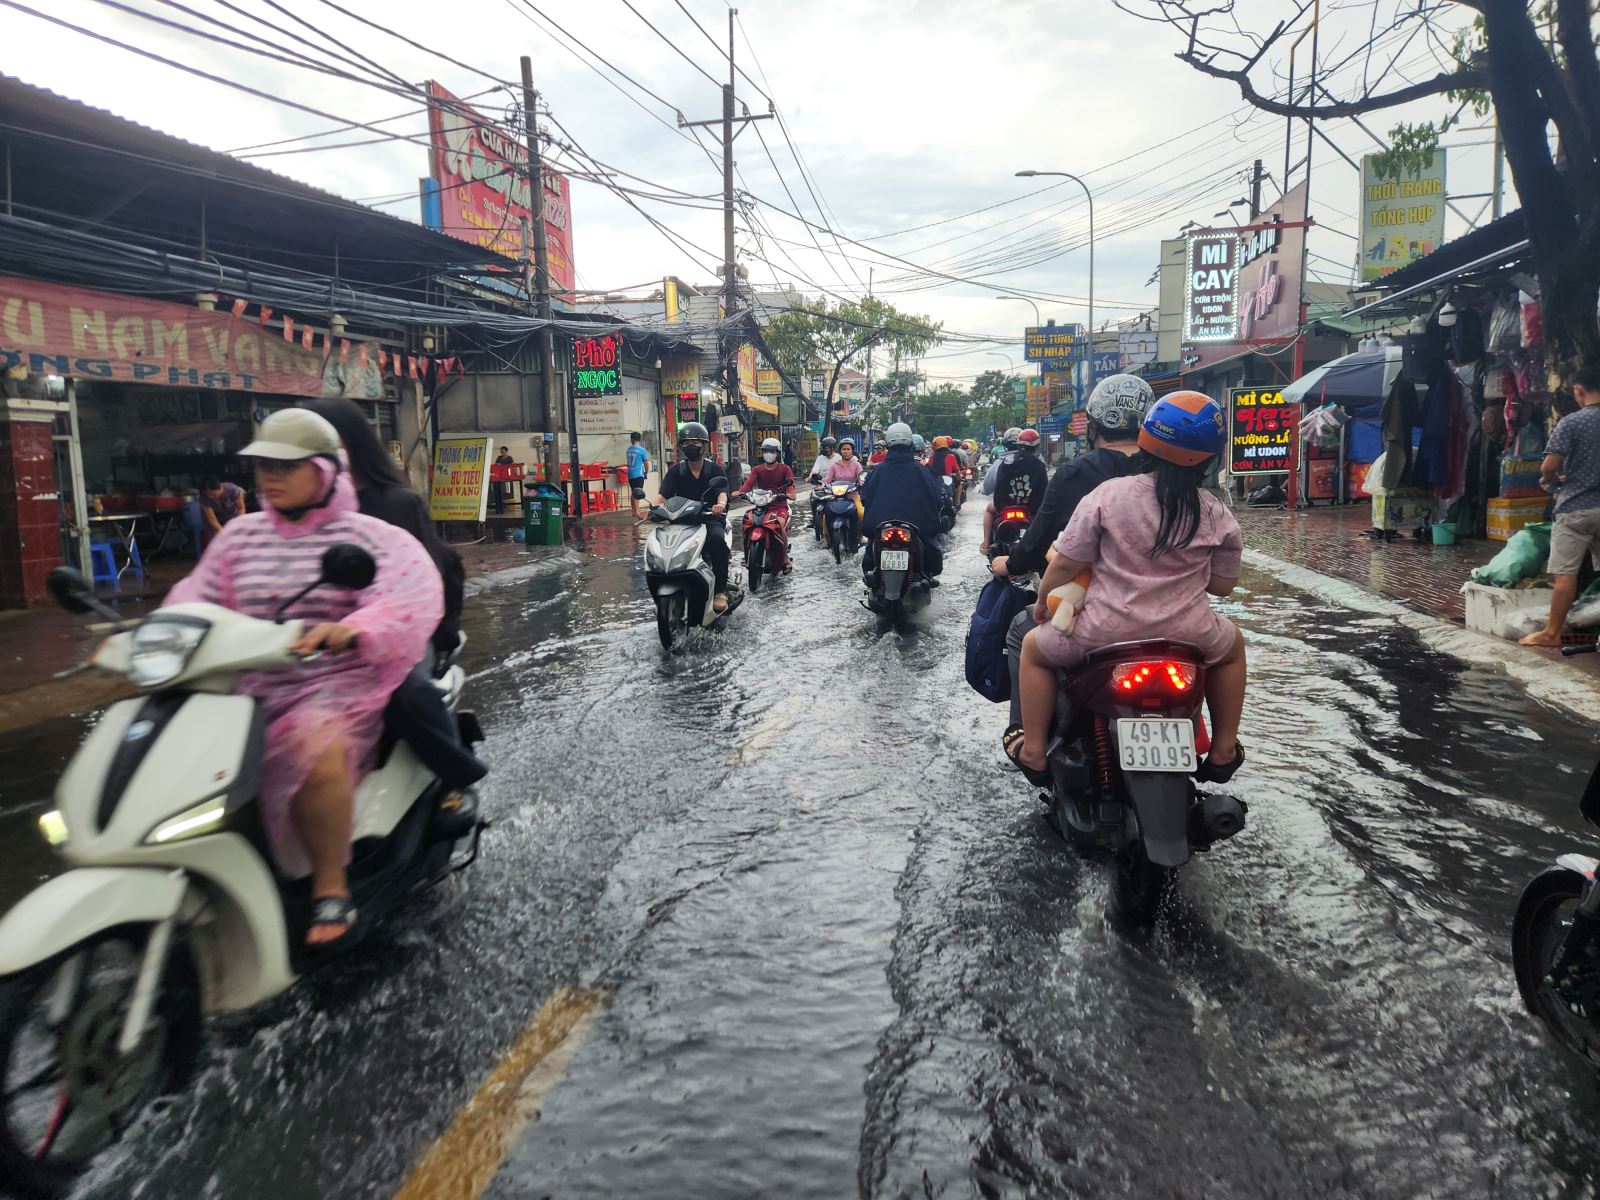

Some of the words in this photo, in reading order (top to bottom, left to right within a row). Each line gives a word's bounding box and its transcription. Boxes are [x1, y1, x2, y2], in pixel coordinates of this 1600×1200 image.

[1399, 179, 1442, 199] TRANG
[1370, 203, 1406, 228] TỔNG
[1407, 205, 1436, 225] HỢP
[1201, 240, 1229, 265] MÌ
[1192, 268, 1235, 291] CAY
[1202, 305, 1223, 313] UDON
[69, 306, 190, 361] NAM
[202, 325, 319, 377] VANG
[1028, 347, 1042, 358] SH
[1044, 344, 1072, 359] NHẬP
[577, 370, 618, 392] NGỌC
[667, 379, 696, 393] NGỌC
[1115, 394, 1135, 409] VANS
[1235, 391, 1257, 406] MÌ
[1260, 391, 1288, 404] CA
[1258, 446, 1287, 457] UDON
[434, 486, 454, 497] NAM
[456, 486, 481, 497] VANG
[1130, 722, 1181, 744] 49-K1
[1125, 745, 1192, 767] 330.95
